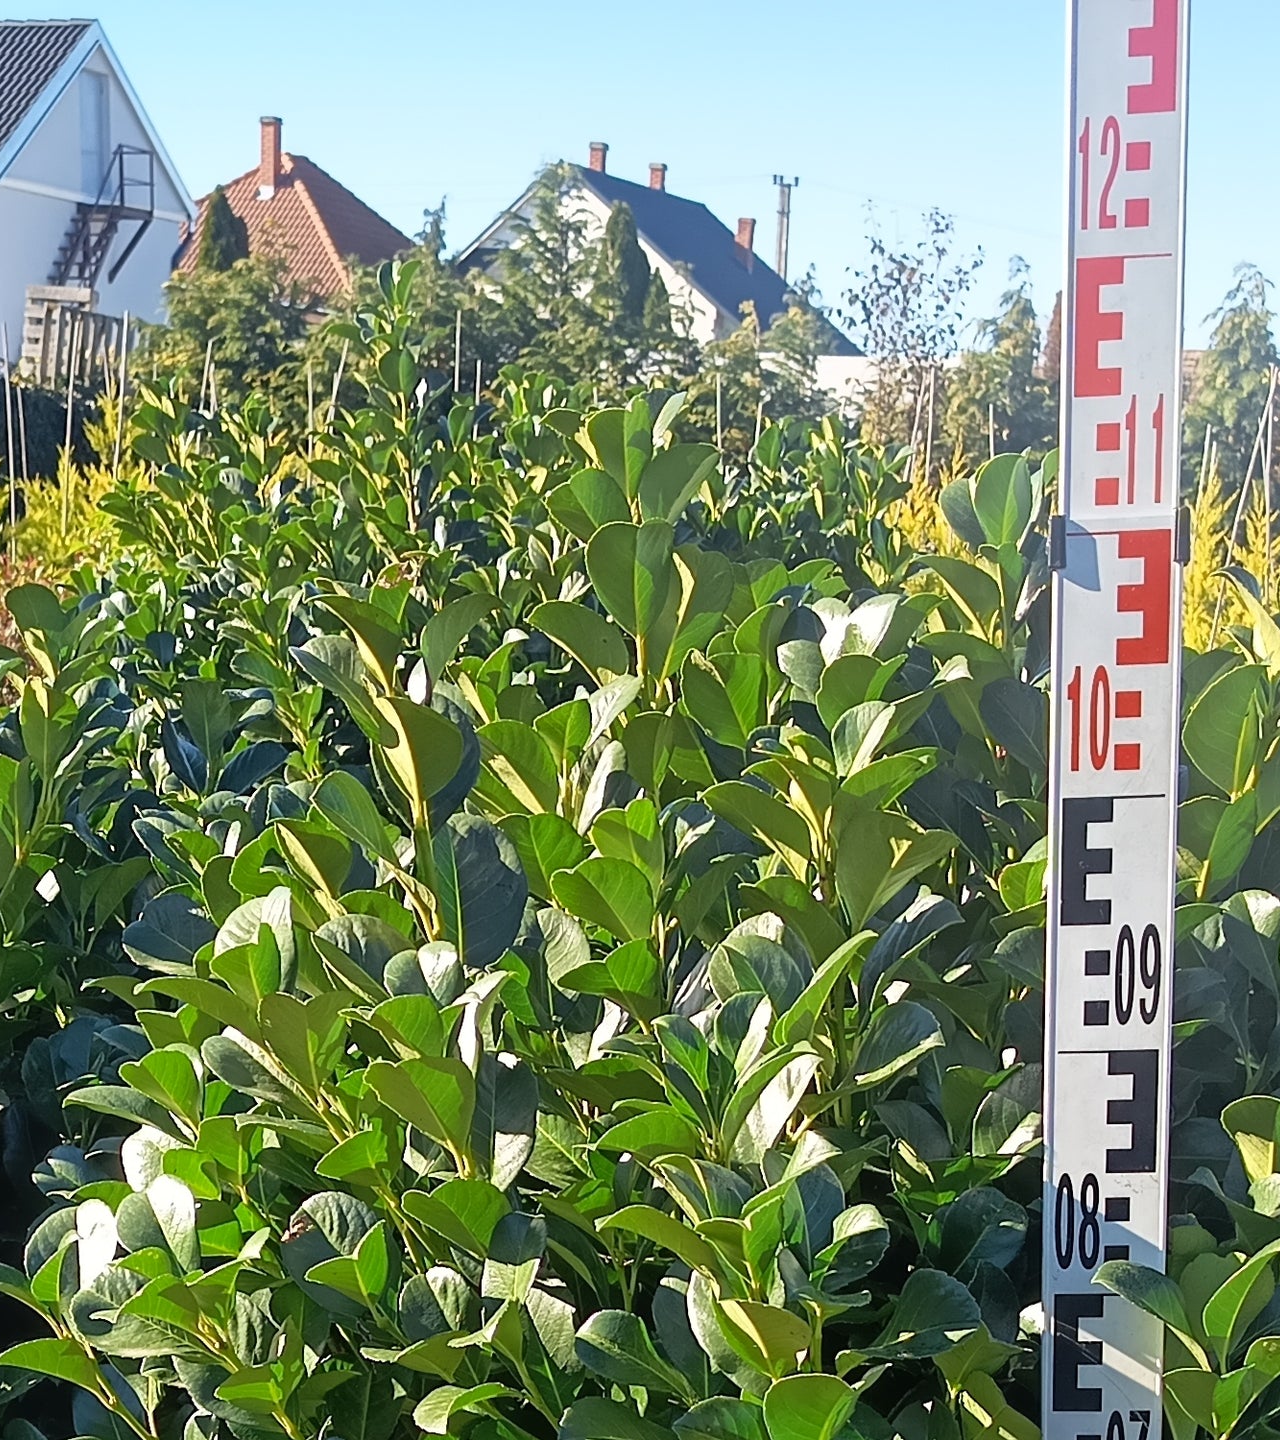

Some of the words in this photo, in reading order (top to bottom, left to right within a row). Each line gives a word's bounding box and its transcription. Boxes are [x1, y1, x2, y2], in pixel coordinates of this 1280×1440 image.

[1079, 115, 1120, 229] 12
[1125, 394, 1163, 505] 11
[1067, 664, 1111, 772] 10
[1114, 923, 1161, 1025] 09
[1054, 1173, 1100, 1269] 08
